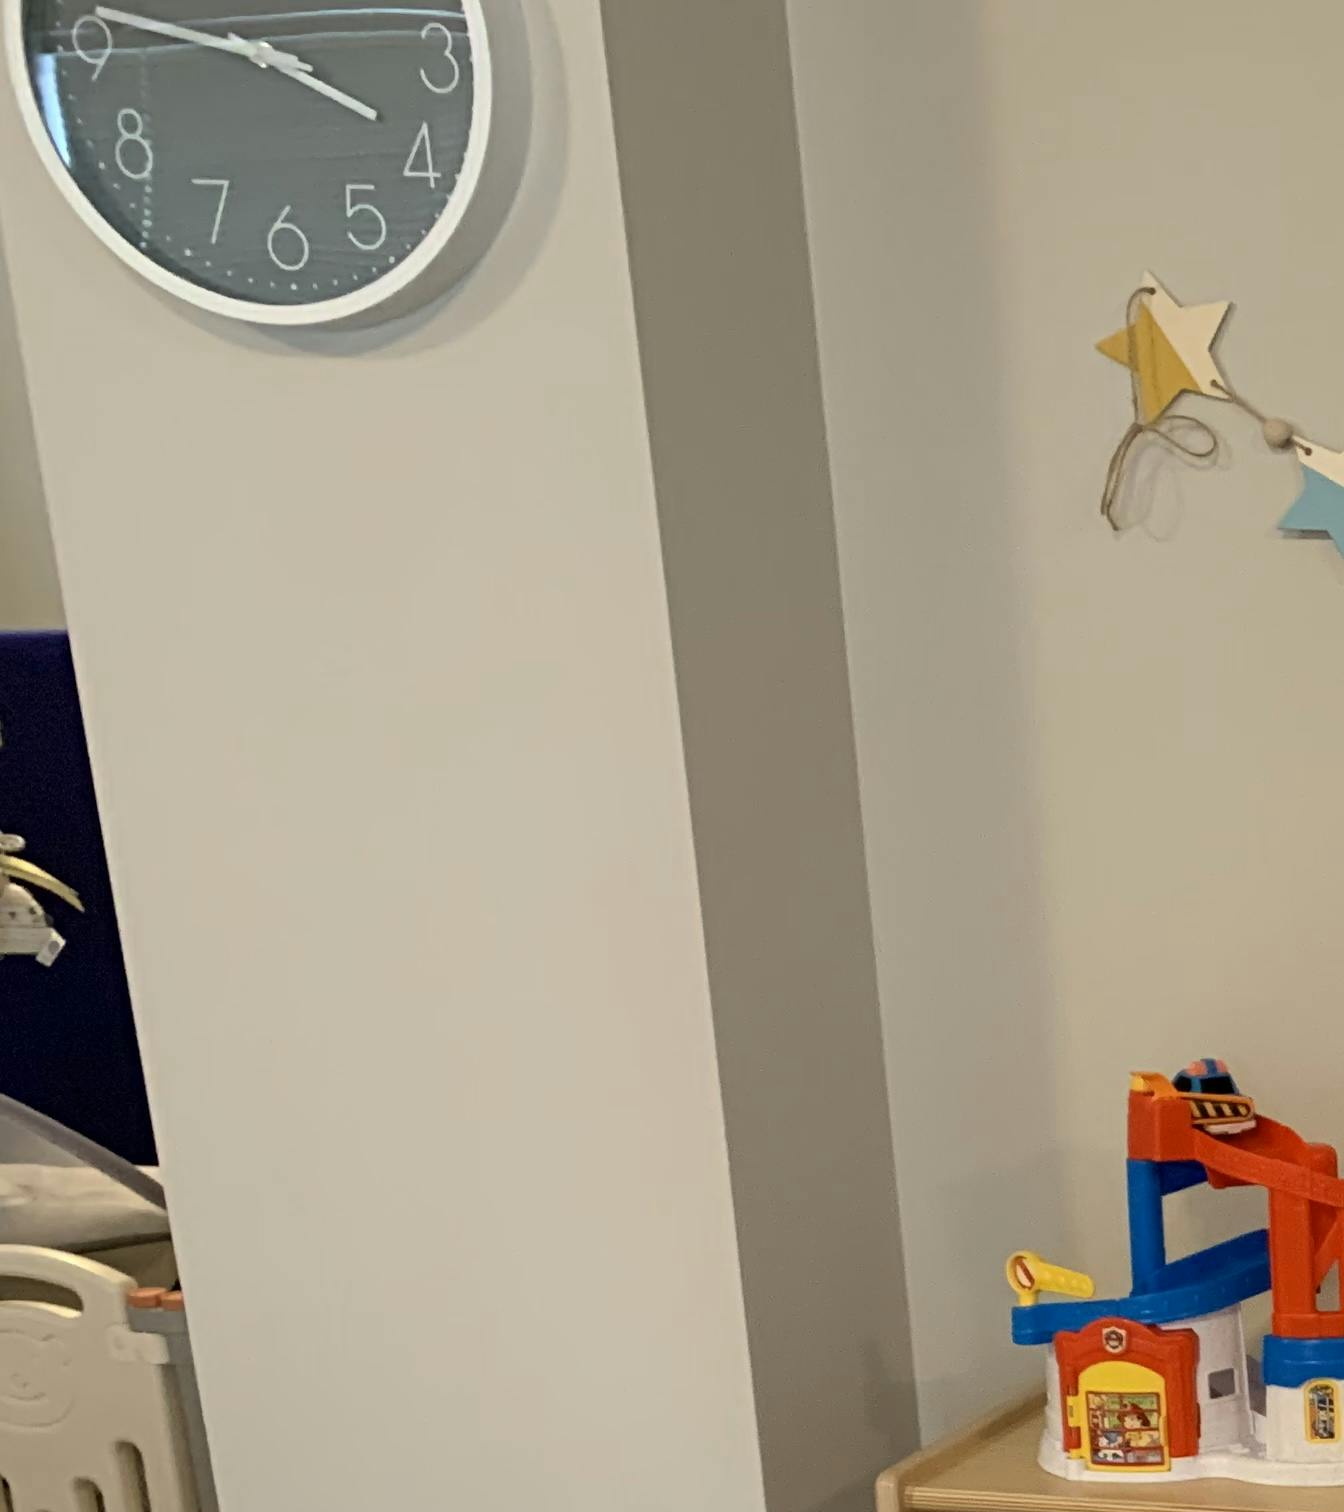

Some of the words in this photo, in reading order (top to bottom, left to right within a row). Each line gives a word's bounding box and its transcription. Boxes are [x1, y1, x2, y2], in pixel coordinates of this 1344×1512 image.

[72, 15, 113, 81] 9
[420, 22, 459, 94] 3
[115, 108, 153, 179] 8
[403, 122, 442, 188] 4
[191, 178, 230, 244] 7
[267, 205, 309, 271] 6
[346, 184, 387, 250] 5
